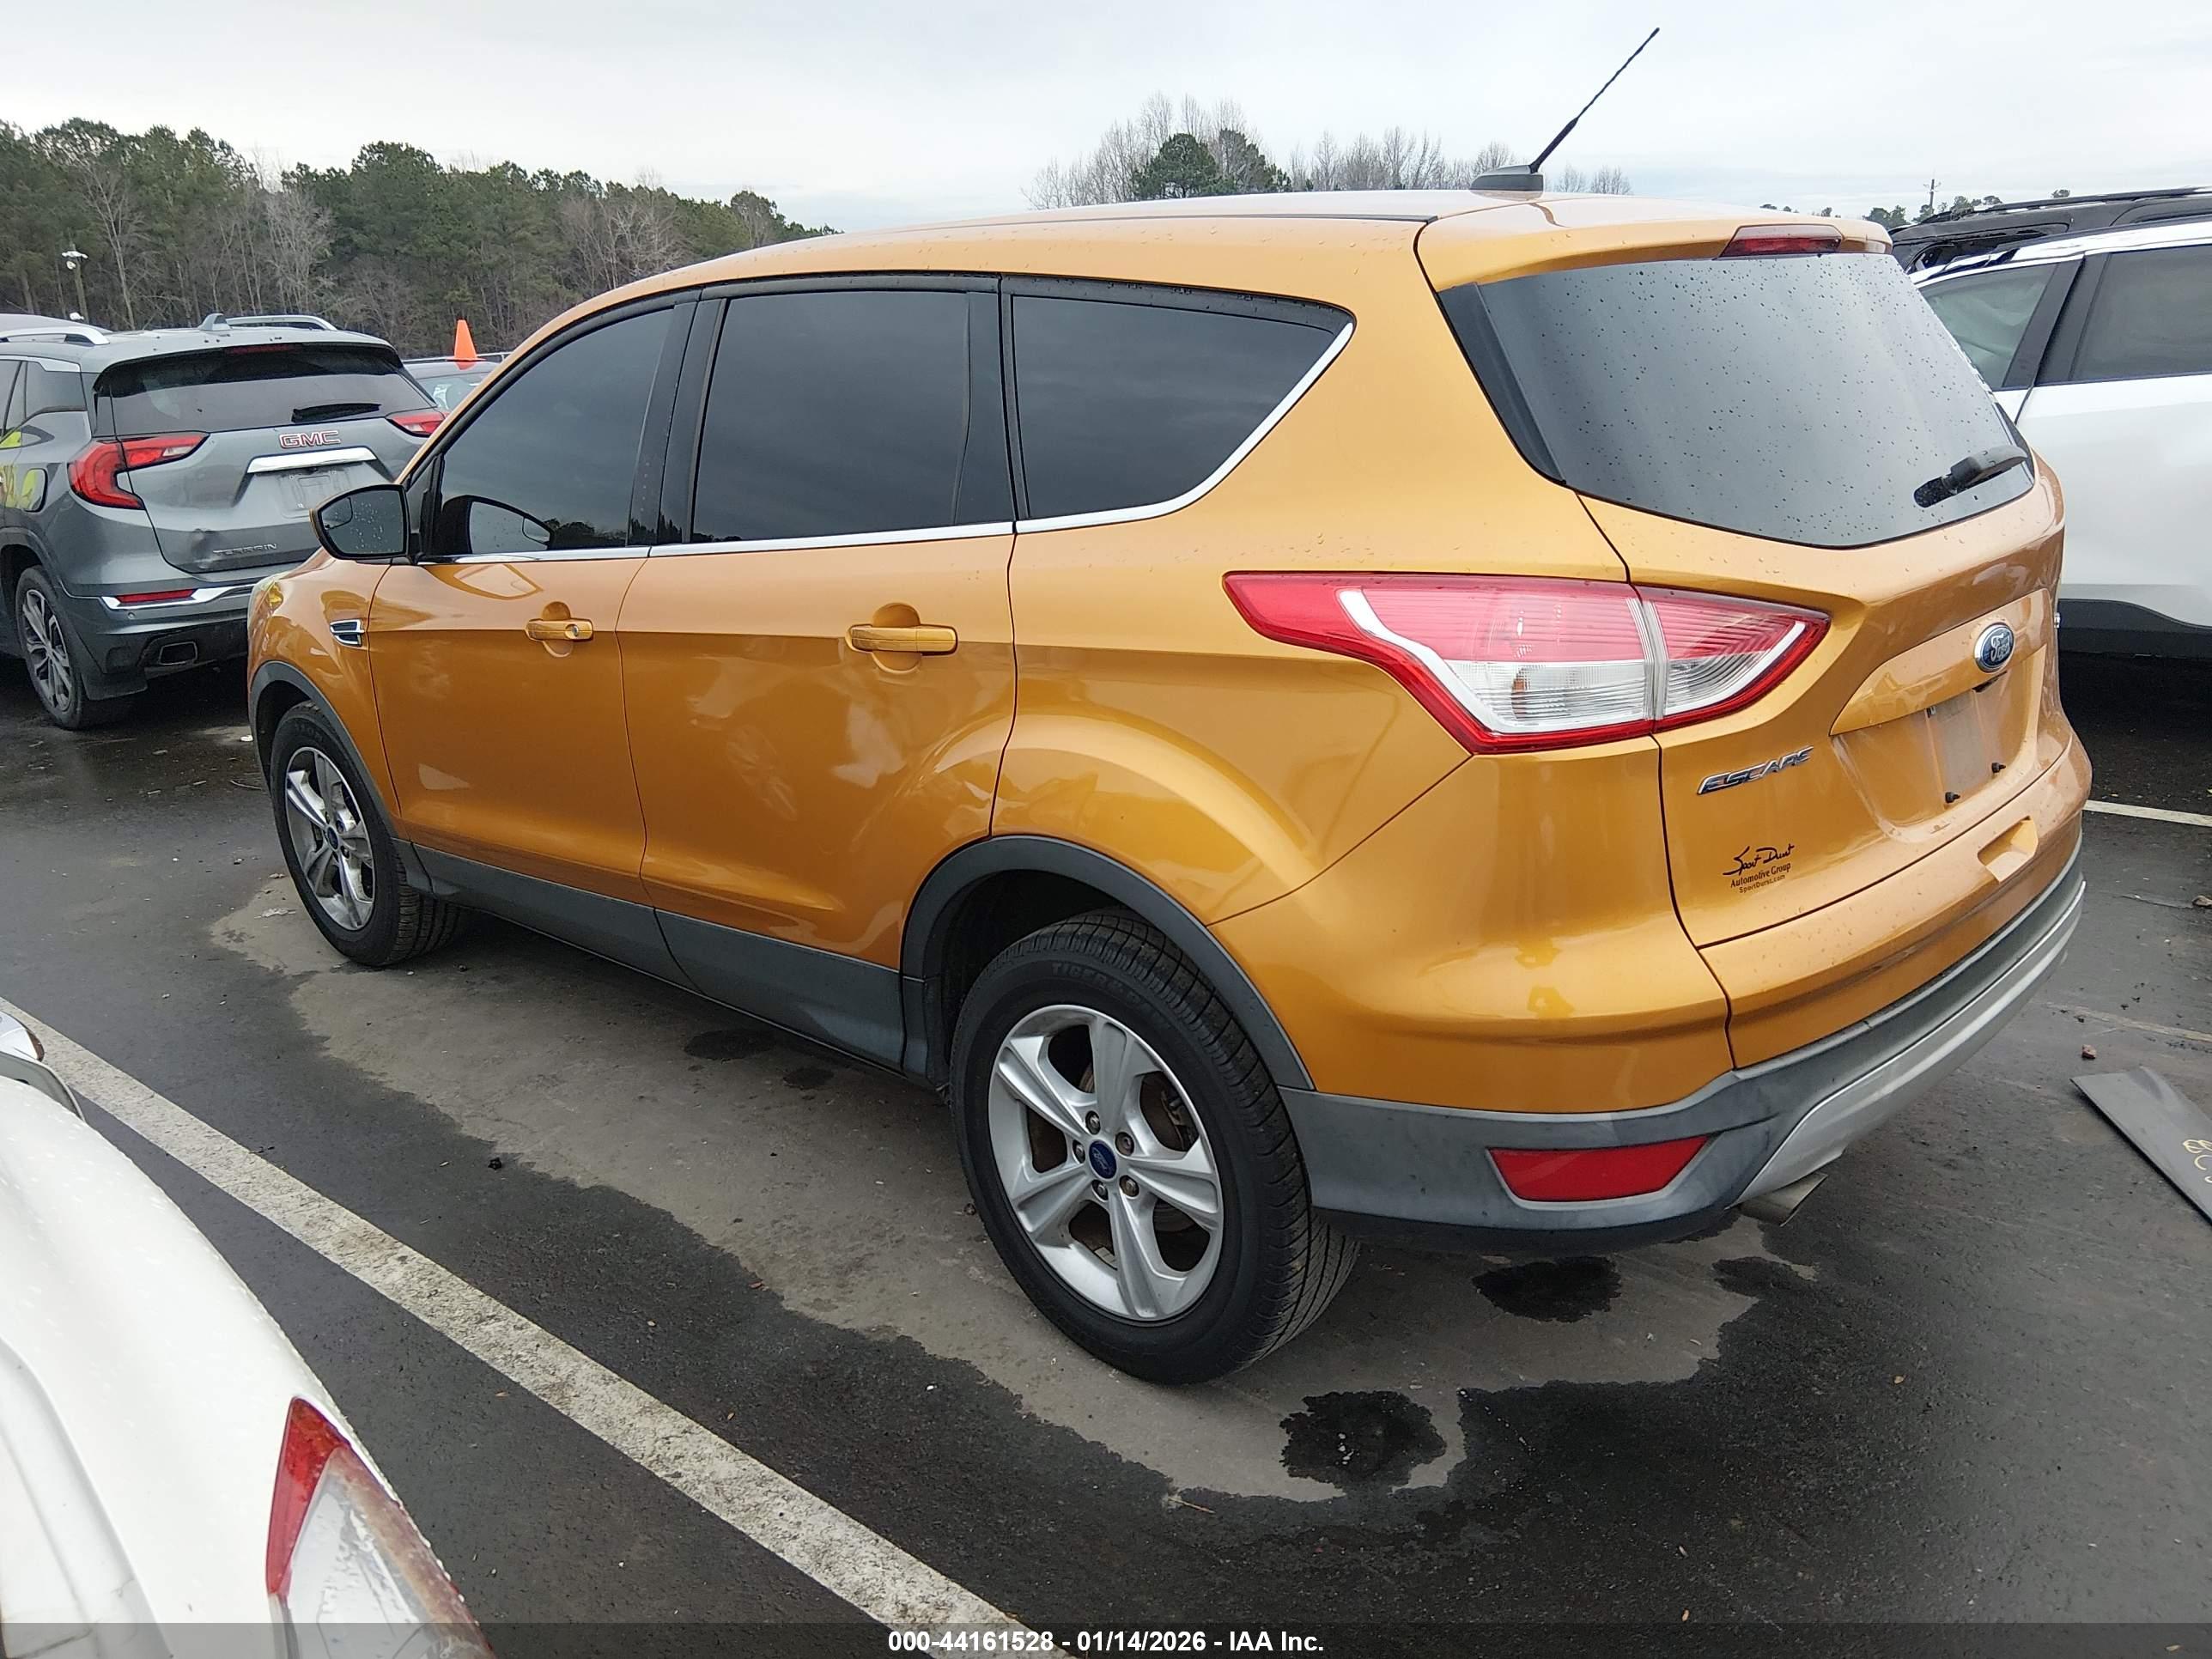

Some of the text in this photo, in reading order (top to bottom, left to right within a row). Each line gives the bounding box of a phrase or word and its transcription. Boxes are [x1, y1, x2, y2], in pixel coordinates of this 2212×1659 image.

[279, 430, 341, 448] GMC
[1697, 744, 1814, 795] ESCAPE
[1730, 862, 1791, 889] Automotive Group
[1739, 874, 1786, 894] SportDurst.com
